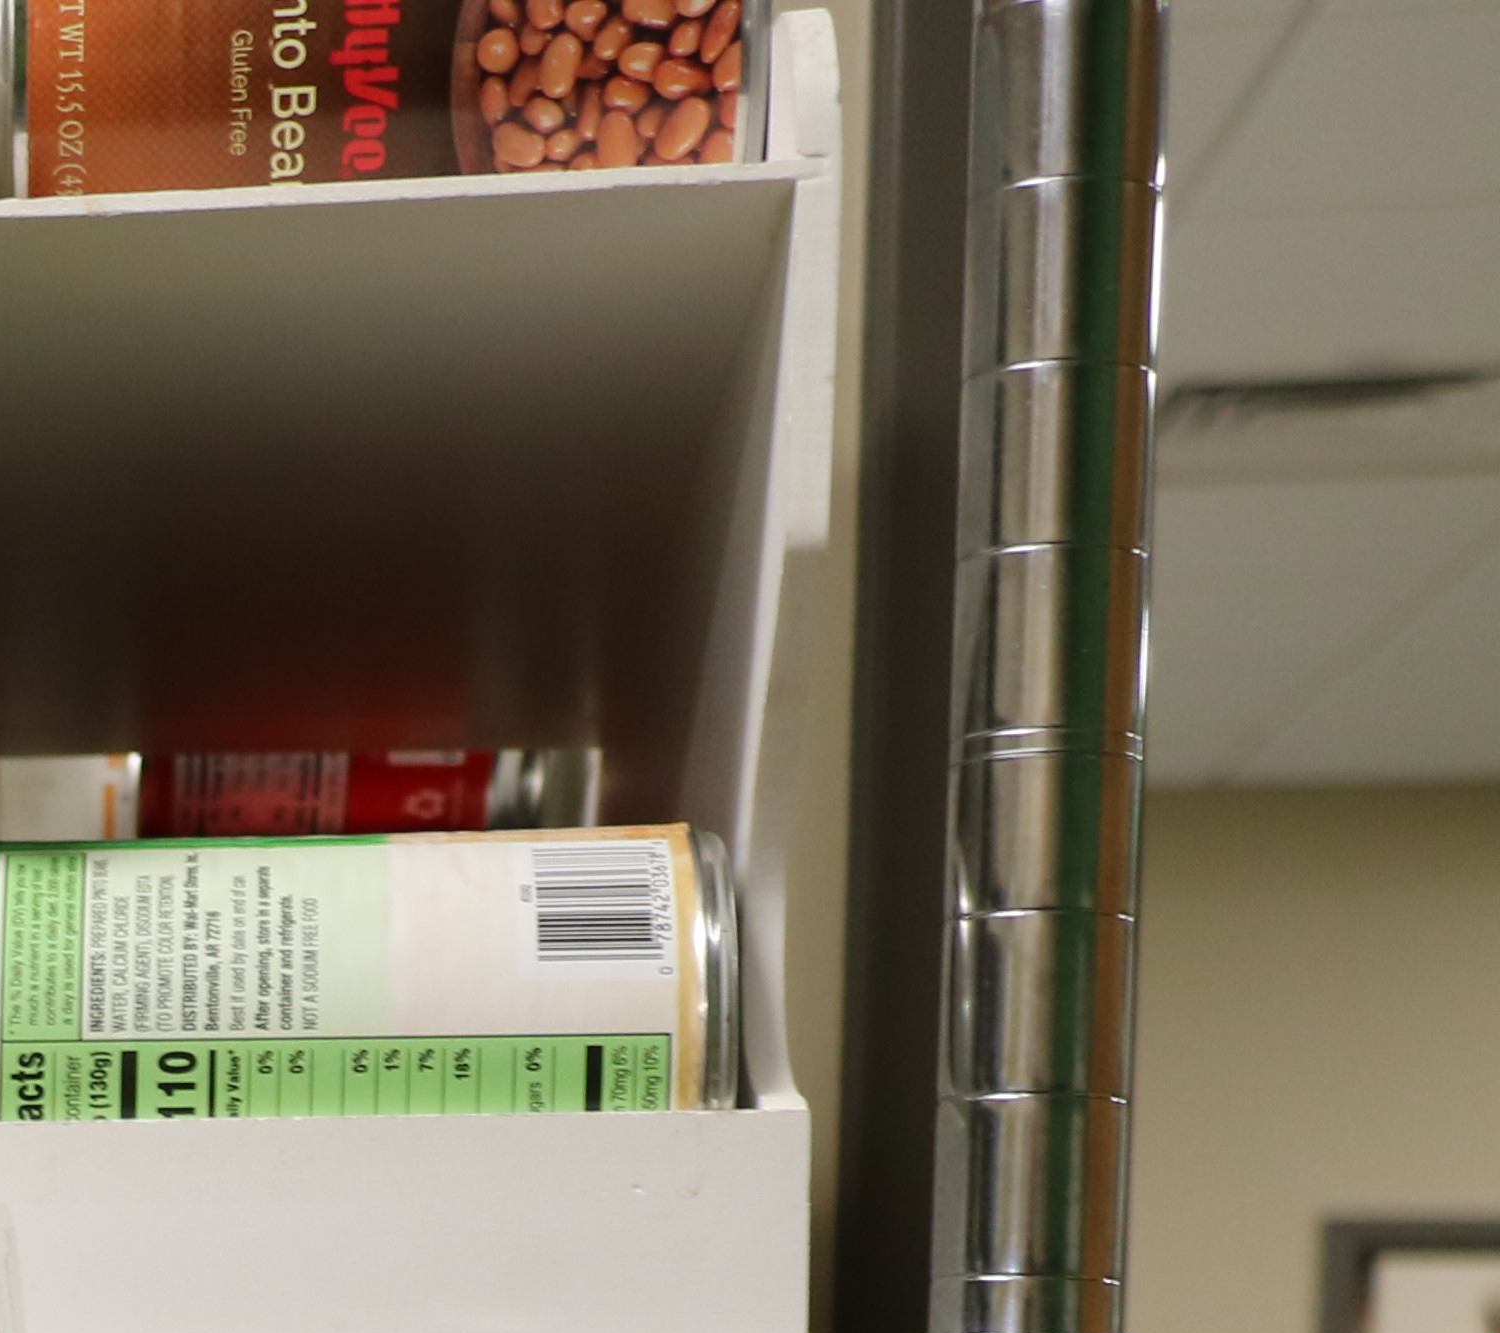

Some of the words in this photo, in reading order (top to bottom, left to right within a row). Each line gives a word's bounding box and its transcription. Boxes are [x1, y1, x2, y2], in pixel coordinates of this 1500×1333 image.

[231, 29, 252, 101] Gluten
[231, 106, 250, 157] Free
[301, 898, 316, 922] FOOD
[654, 893, 673, 943] 78742
[205, 943, 219, 957] AR
[301, 925, 316, 947] FREE
[111, 941, 126, 986] CALCIUM
[256, 948, 273, 996] opening,
[277, 948, 290, 969] and
[301, 950, 316, 992] SODIUM
[90, 951, 104, 1032] INGREDIENTS:
[111, 989, 128, 1031] WATER,
[182, 954, 196, 1031] DISTRIBUTED
[205, 962, 222, 1031] Bentonville,
[277, 972, 291, 1030] container
[254, 1000, 269, 1030] After
[302, 1006, 317, 1029] NOT
[89, 1052, 109, 1109] (130g)
[256, 1051, 272, 1074] 0%
[288, 1051, 303, 1074] 0%
[353, 1050, 368, 1074] 0%
[385, 1050, 401, 1072] 1%
[419, 1049, 436, 1072] 7%
[454, 1049, 472, 1080] 18%
[9, 1053, 43, 1120] acts
[156, 1051, 195, 1117] 110
